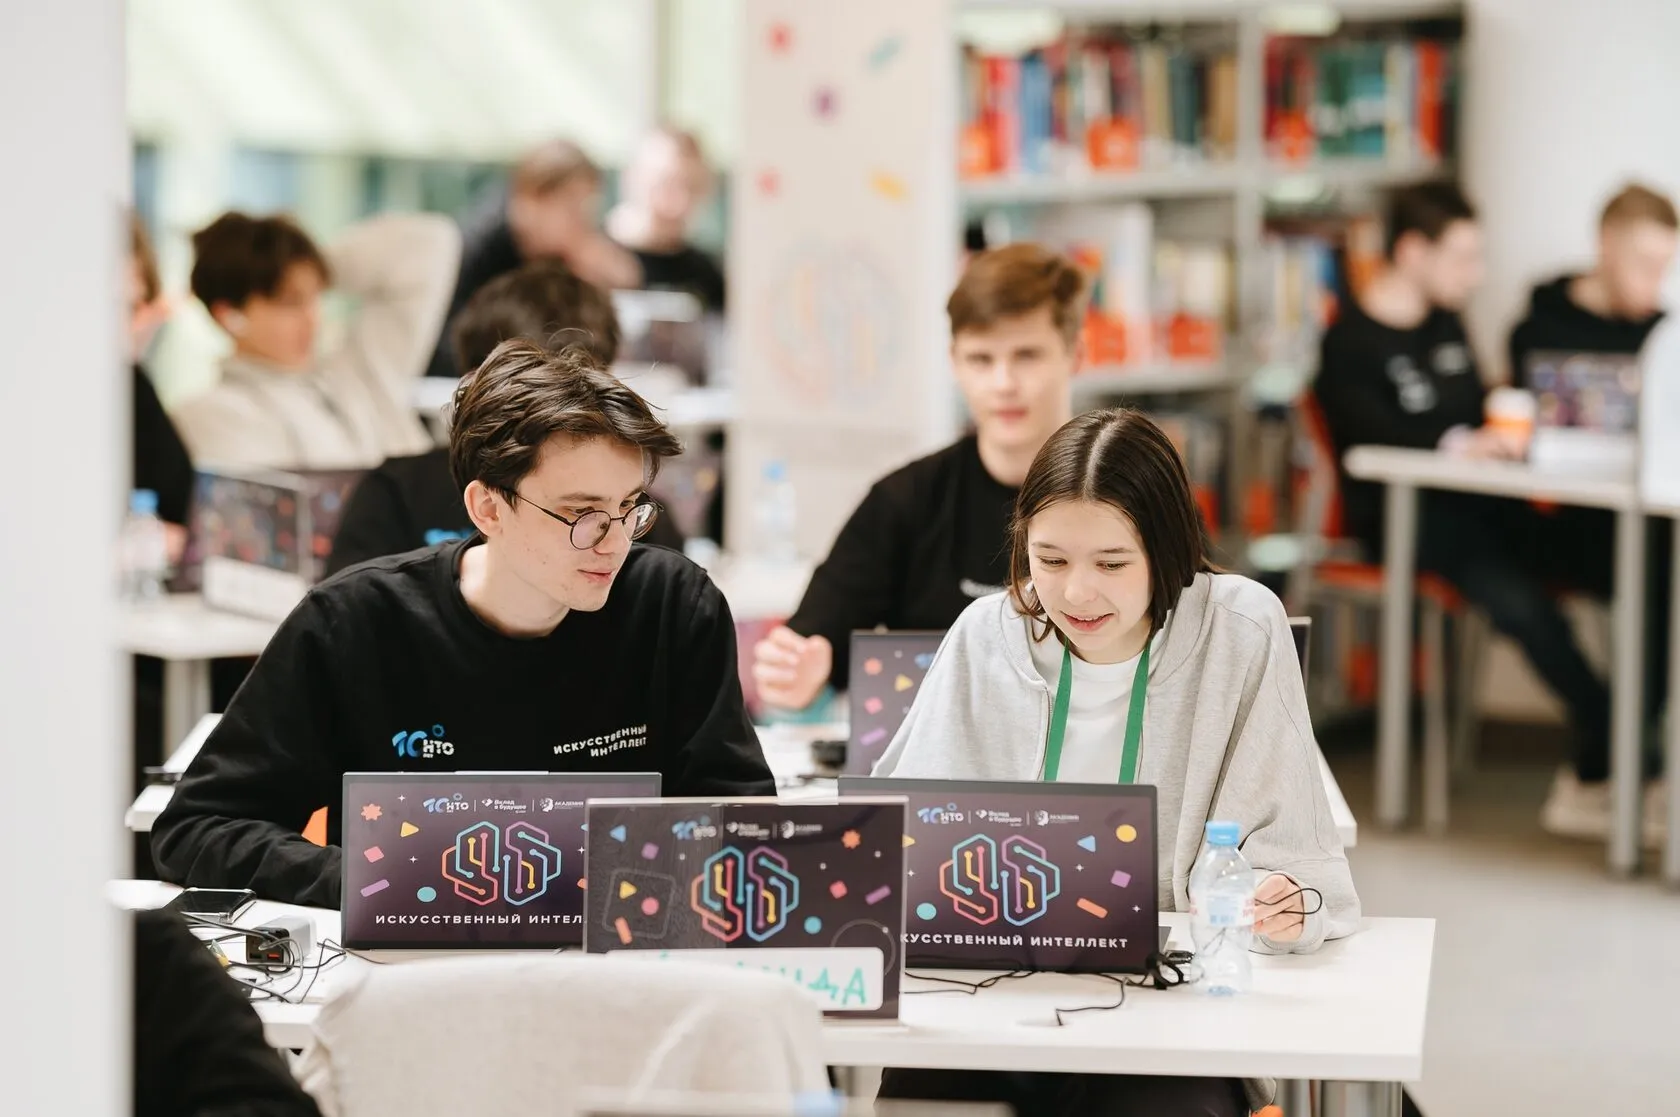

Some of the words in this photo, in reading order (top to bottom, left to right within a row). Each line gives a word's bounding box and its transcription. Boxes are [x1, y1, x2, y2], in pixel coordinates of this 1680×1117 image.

[423, 739, 455, 755] НТО
[590, 737, 647, 757] ИНТЕЛЛЕКТ
[446, 802, 469, 810] НТО
[940, 812, 964, 822] НТО
[375, 914, 521, 924] ИСКУССТВЕННЫЙ
[529, 915, 584, 924] ИНТЕЛ
[1030, 936, 1128, 948] ИНТЕЛЛЕКТ
